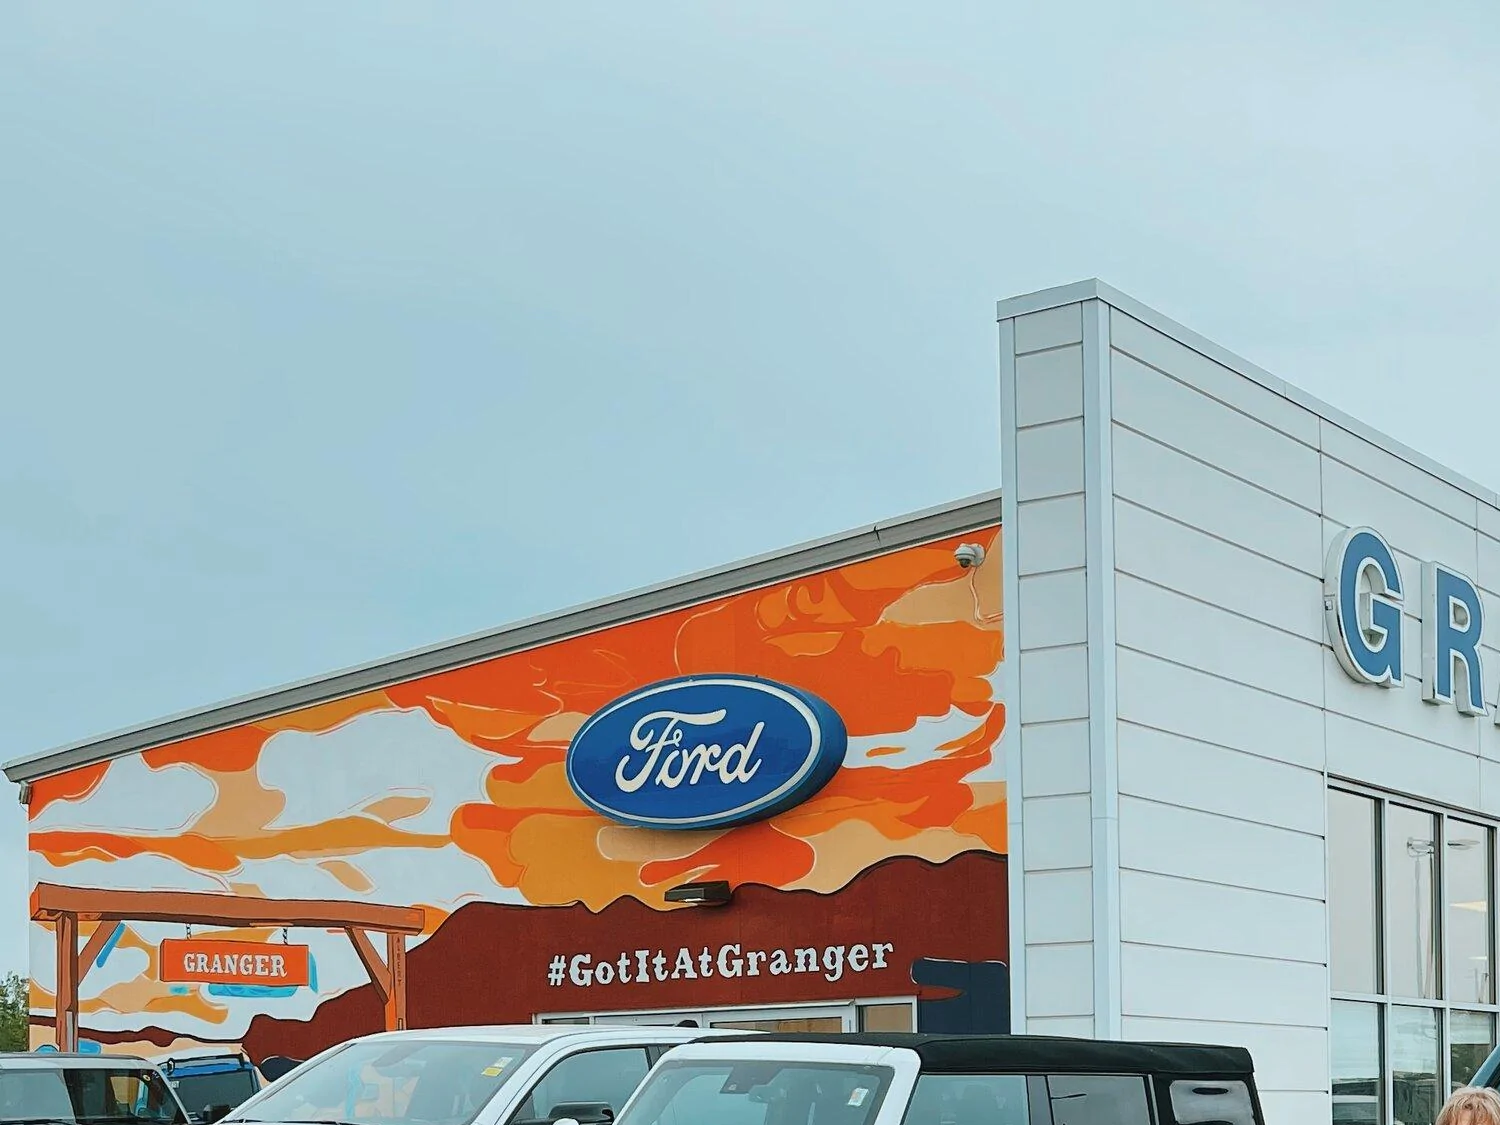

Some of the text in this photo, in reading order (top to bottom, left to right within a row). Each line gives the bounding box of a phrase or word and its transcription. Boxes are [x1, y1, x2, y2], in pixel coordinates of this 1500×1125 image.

[615, 708, 765, 793] Ford
[183, 952, 288, 978] GRANGER
[548, 943, 894, 988] #GotItAtGranger
